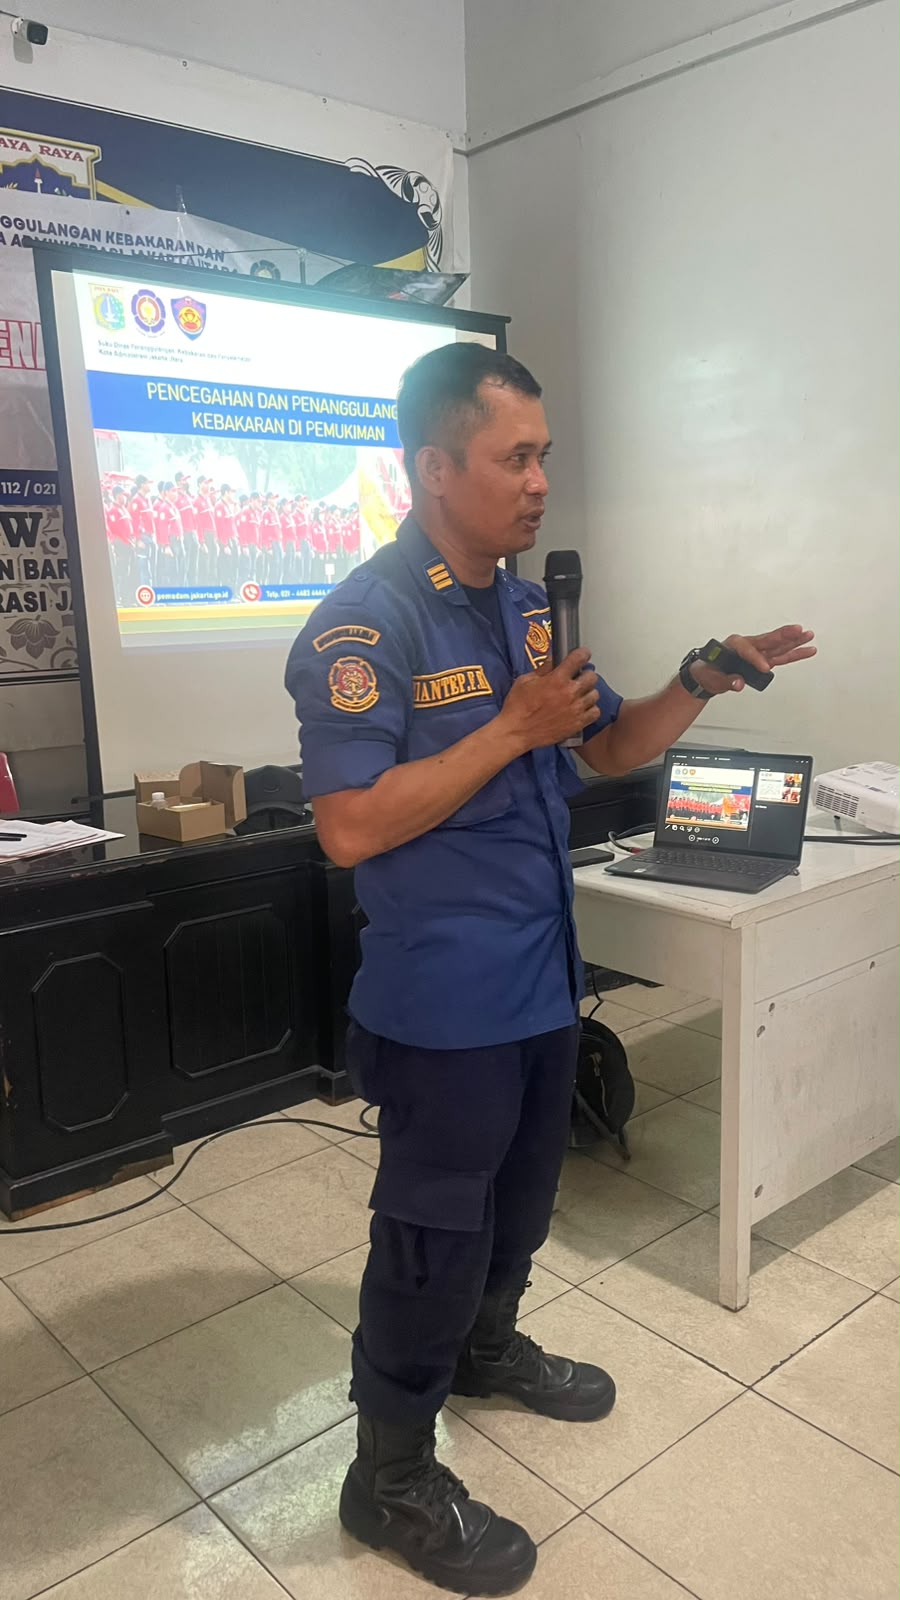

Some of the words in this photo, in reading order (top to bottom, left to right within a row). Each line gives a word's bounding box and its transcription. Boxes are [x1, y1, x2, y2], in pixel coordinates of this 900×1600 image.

[39, 145, 84, 162] RAYA
[0, 215, 102, 242] GGULANGAN
[106, 230, 195, 254] KEBAKARAN
[197, 244, 225, 263] DAN
[146, 382, 253, 408] PENCEGAHAN
[257, 391, 289, 411] DAN
[292, 394, 399, 421] PENANGGULANG
[191, 411, 285, 434] KEBAKARAN
[288, 419, 302, 436] DI
[306, 420, 386, 441] PEMUKIMAN
[1, 482, 21, 495] 112
[33, 482, 57, 495] 021
